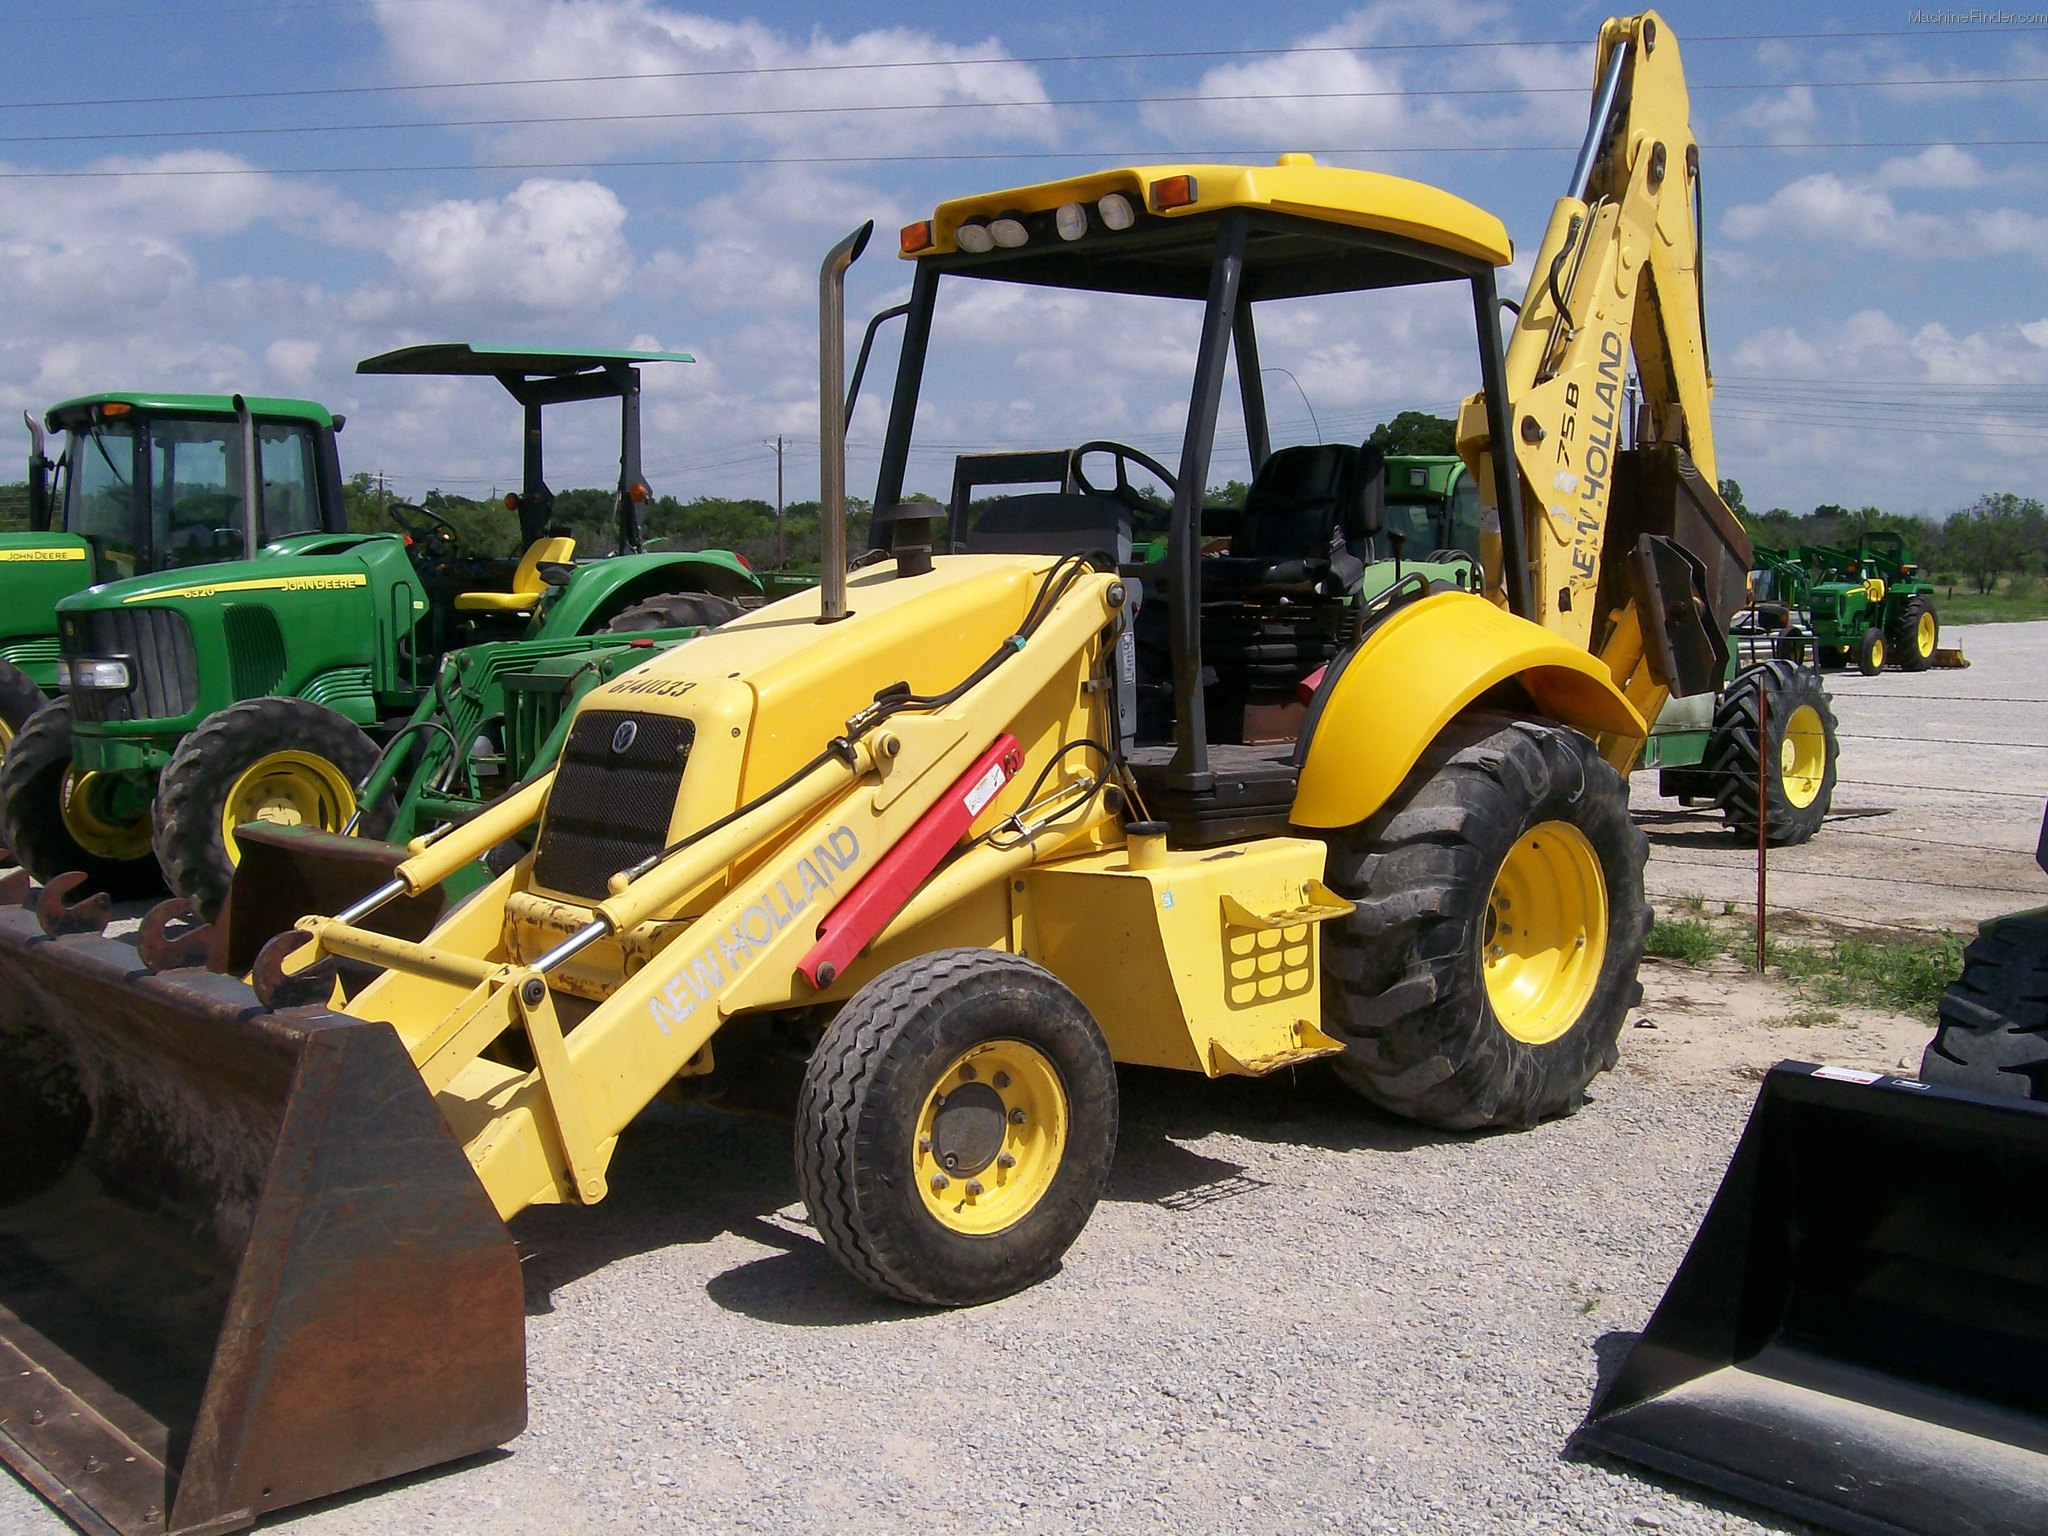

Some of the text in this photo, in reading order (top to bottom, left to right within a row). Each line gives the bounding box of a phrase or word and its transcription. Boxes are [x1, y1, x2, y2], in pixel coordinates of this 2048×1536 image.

[1581, 330, 1622, 504] HOLLAND
[184, 586, 215, 599] 6320
[281, 579, 356, 592] JOHN DEERE
[649, 825, 860, 1037] NEW HOLLAND
